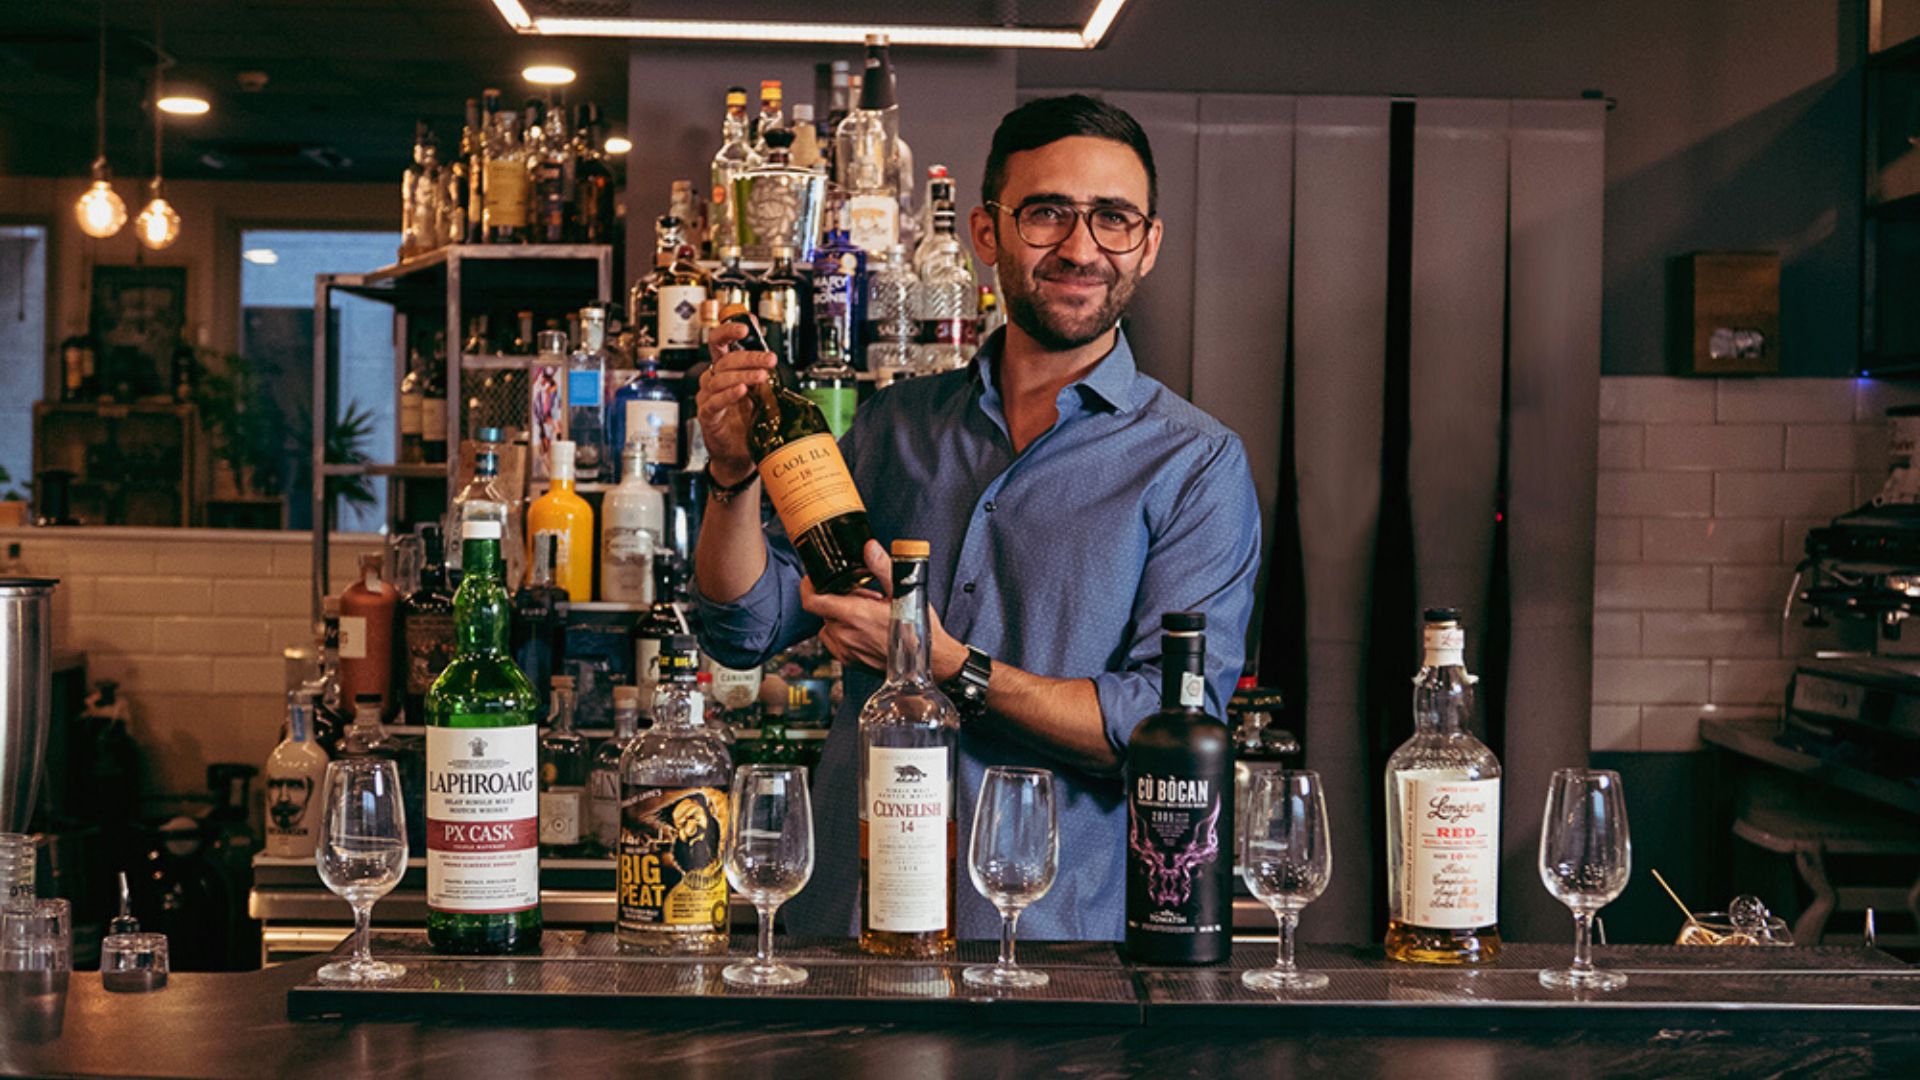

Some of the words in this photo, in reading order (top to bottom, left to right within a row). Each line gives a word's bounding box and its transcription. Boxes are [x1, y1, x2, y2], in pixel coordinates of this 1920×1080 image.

[772, 455, 808, 479] CAOL
[810, 448, 830, 460] ILA
[800, 468, 813, 480] 18
[430, 768, 533, 794] LAPHROAIG
[873, 800, 942, 817] CLYNELISH
[445, 825, 466, 841] PX
[469, 825, 514, 842] CASK
[901, 821, 914, 833] 14
[1437, 827, 1476, 837] RED
[621, 854, 661, 884] BIG
[621, 884, 666, 907] PEAT
